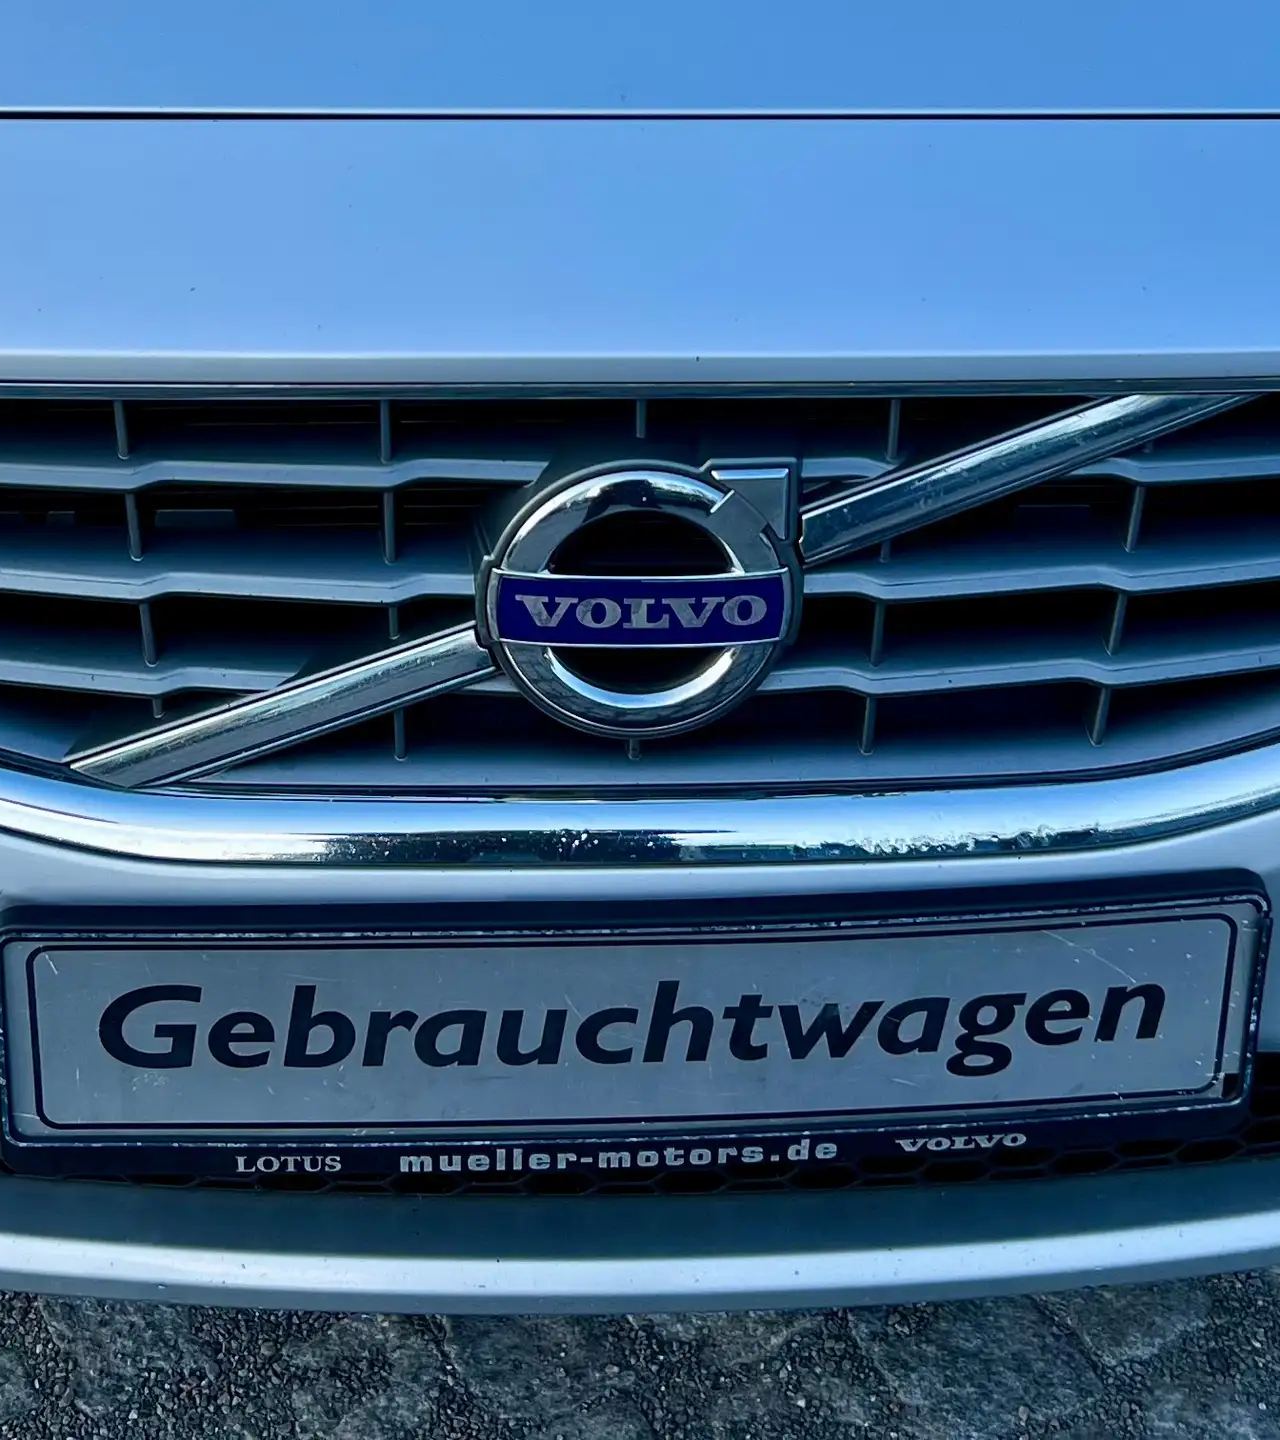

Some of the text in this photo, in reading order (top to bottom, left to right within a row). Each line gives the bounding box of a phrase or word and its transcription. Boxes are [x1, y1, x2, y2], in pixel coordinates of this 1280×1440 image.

[515, 595, 767, 629] VOLVO
[99, 978, 1167, 1077] Gebrauchtwagen
[235, 1132, 1027, 1173] LOTUS mueller-motors.de VOLVO
